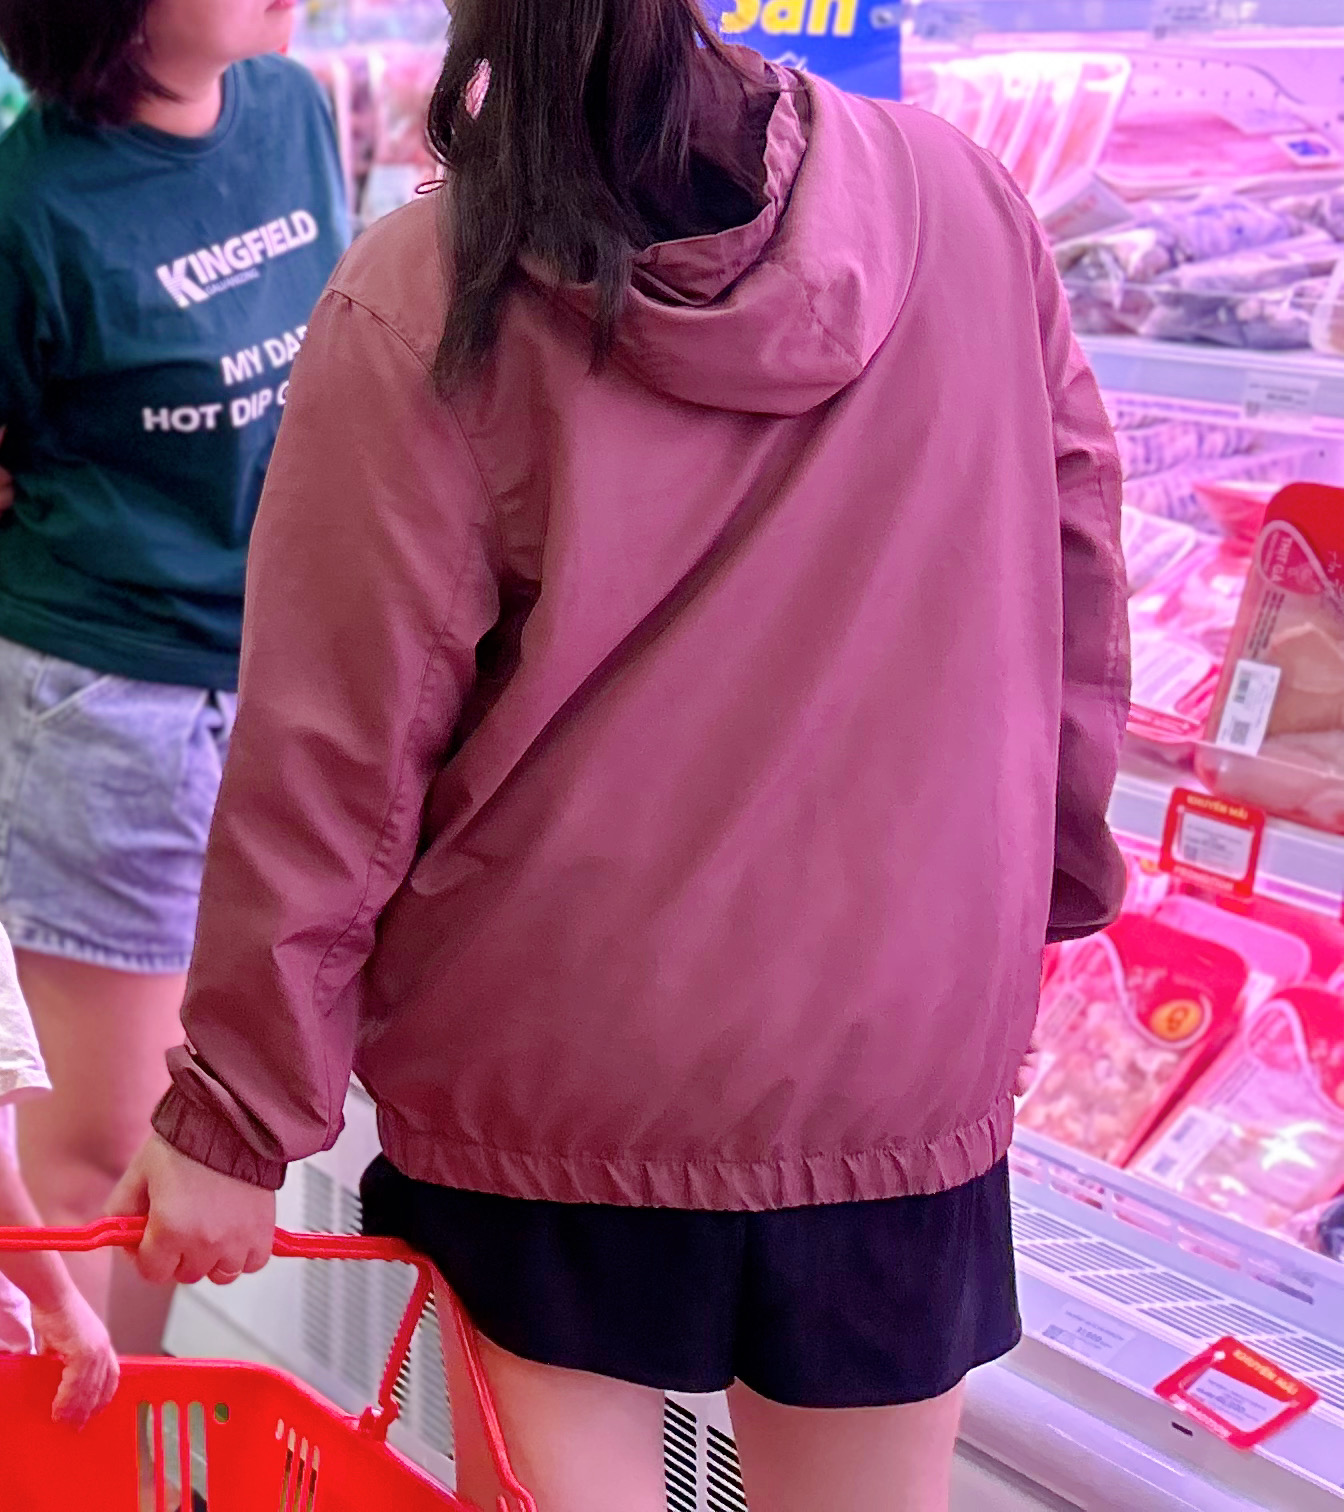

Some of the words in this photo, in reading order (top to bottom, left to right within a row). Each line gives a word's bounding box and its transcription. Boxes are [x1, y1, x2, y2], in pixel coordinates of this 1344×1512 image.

[156, 209, 320, 310] KINGFIELD
[221, 344, 264, 386] MY
[142, 402, 223, 434] HOT
[229, 387, 273, 428] DIP
